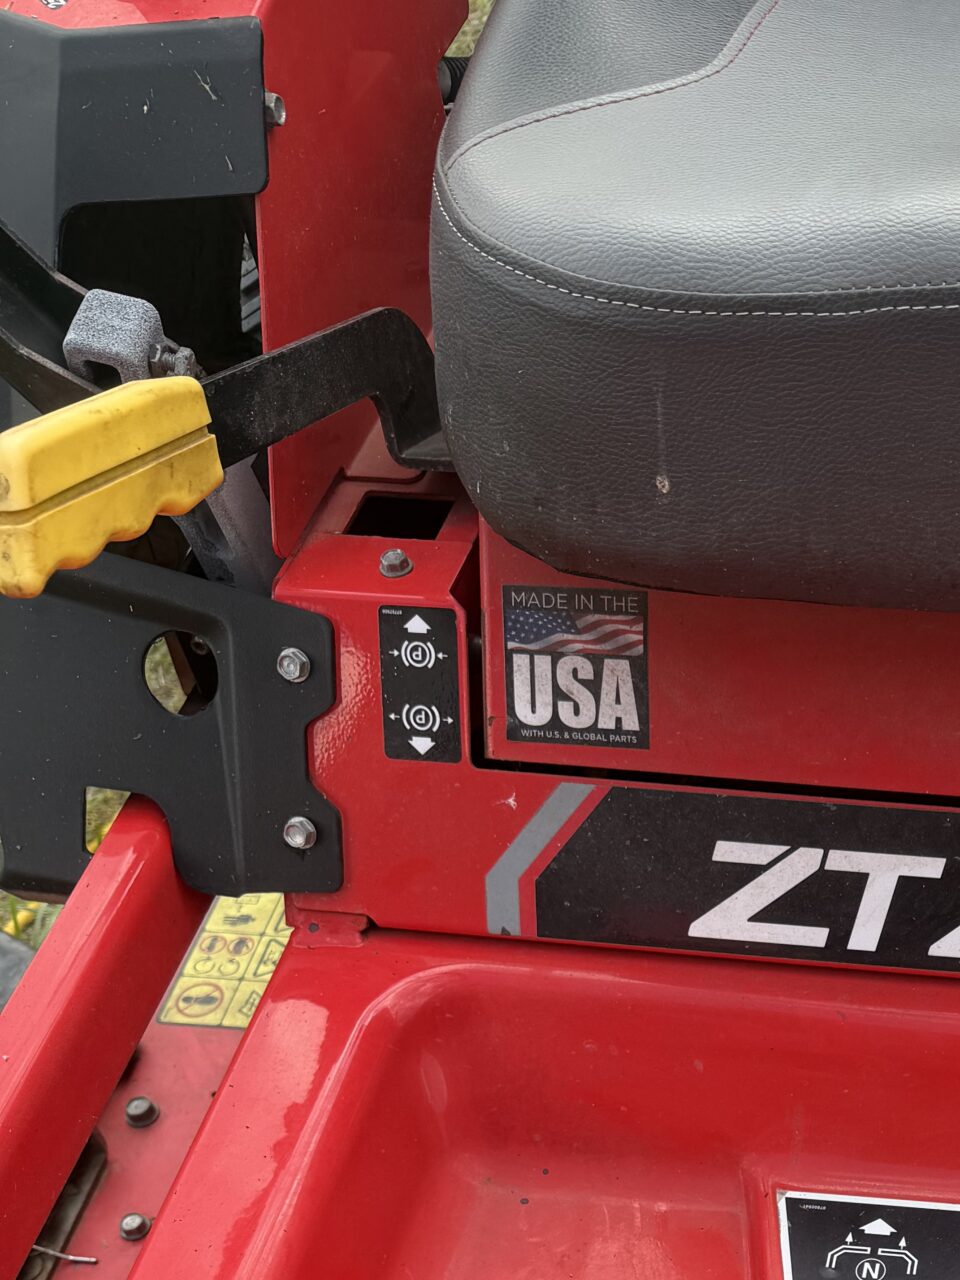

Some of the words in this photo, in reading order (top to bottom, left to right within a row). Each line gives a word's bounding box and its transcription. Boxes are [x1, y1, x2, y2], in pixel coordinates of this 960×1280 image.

[511, 591, 568, 610] MADE
[575, 595, 593, 610] IN
[600, 596, 639, 613] THE
[512, 653, 640, 731] USA
[521, 729, 544, 738] WITH
[546, 730, 562, 739] U.S.
[572, 732, 607, 742] GLOBAL
[610, 735, 637, 743] PARTS
[862, 1262, 881, 1279] N
